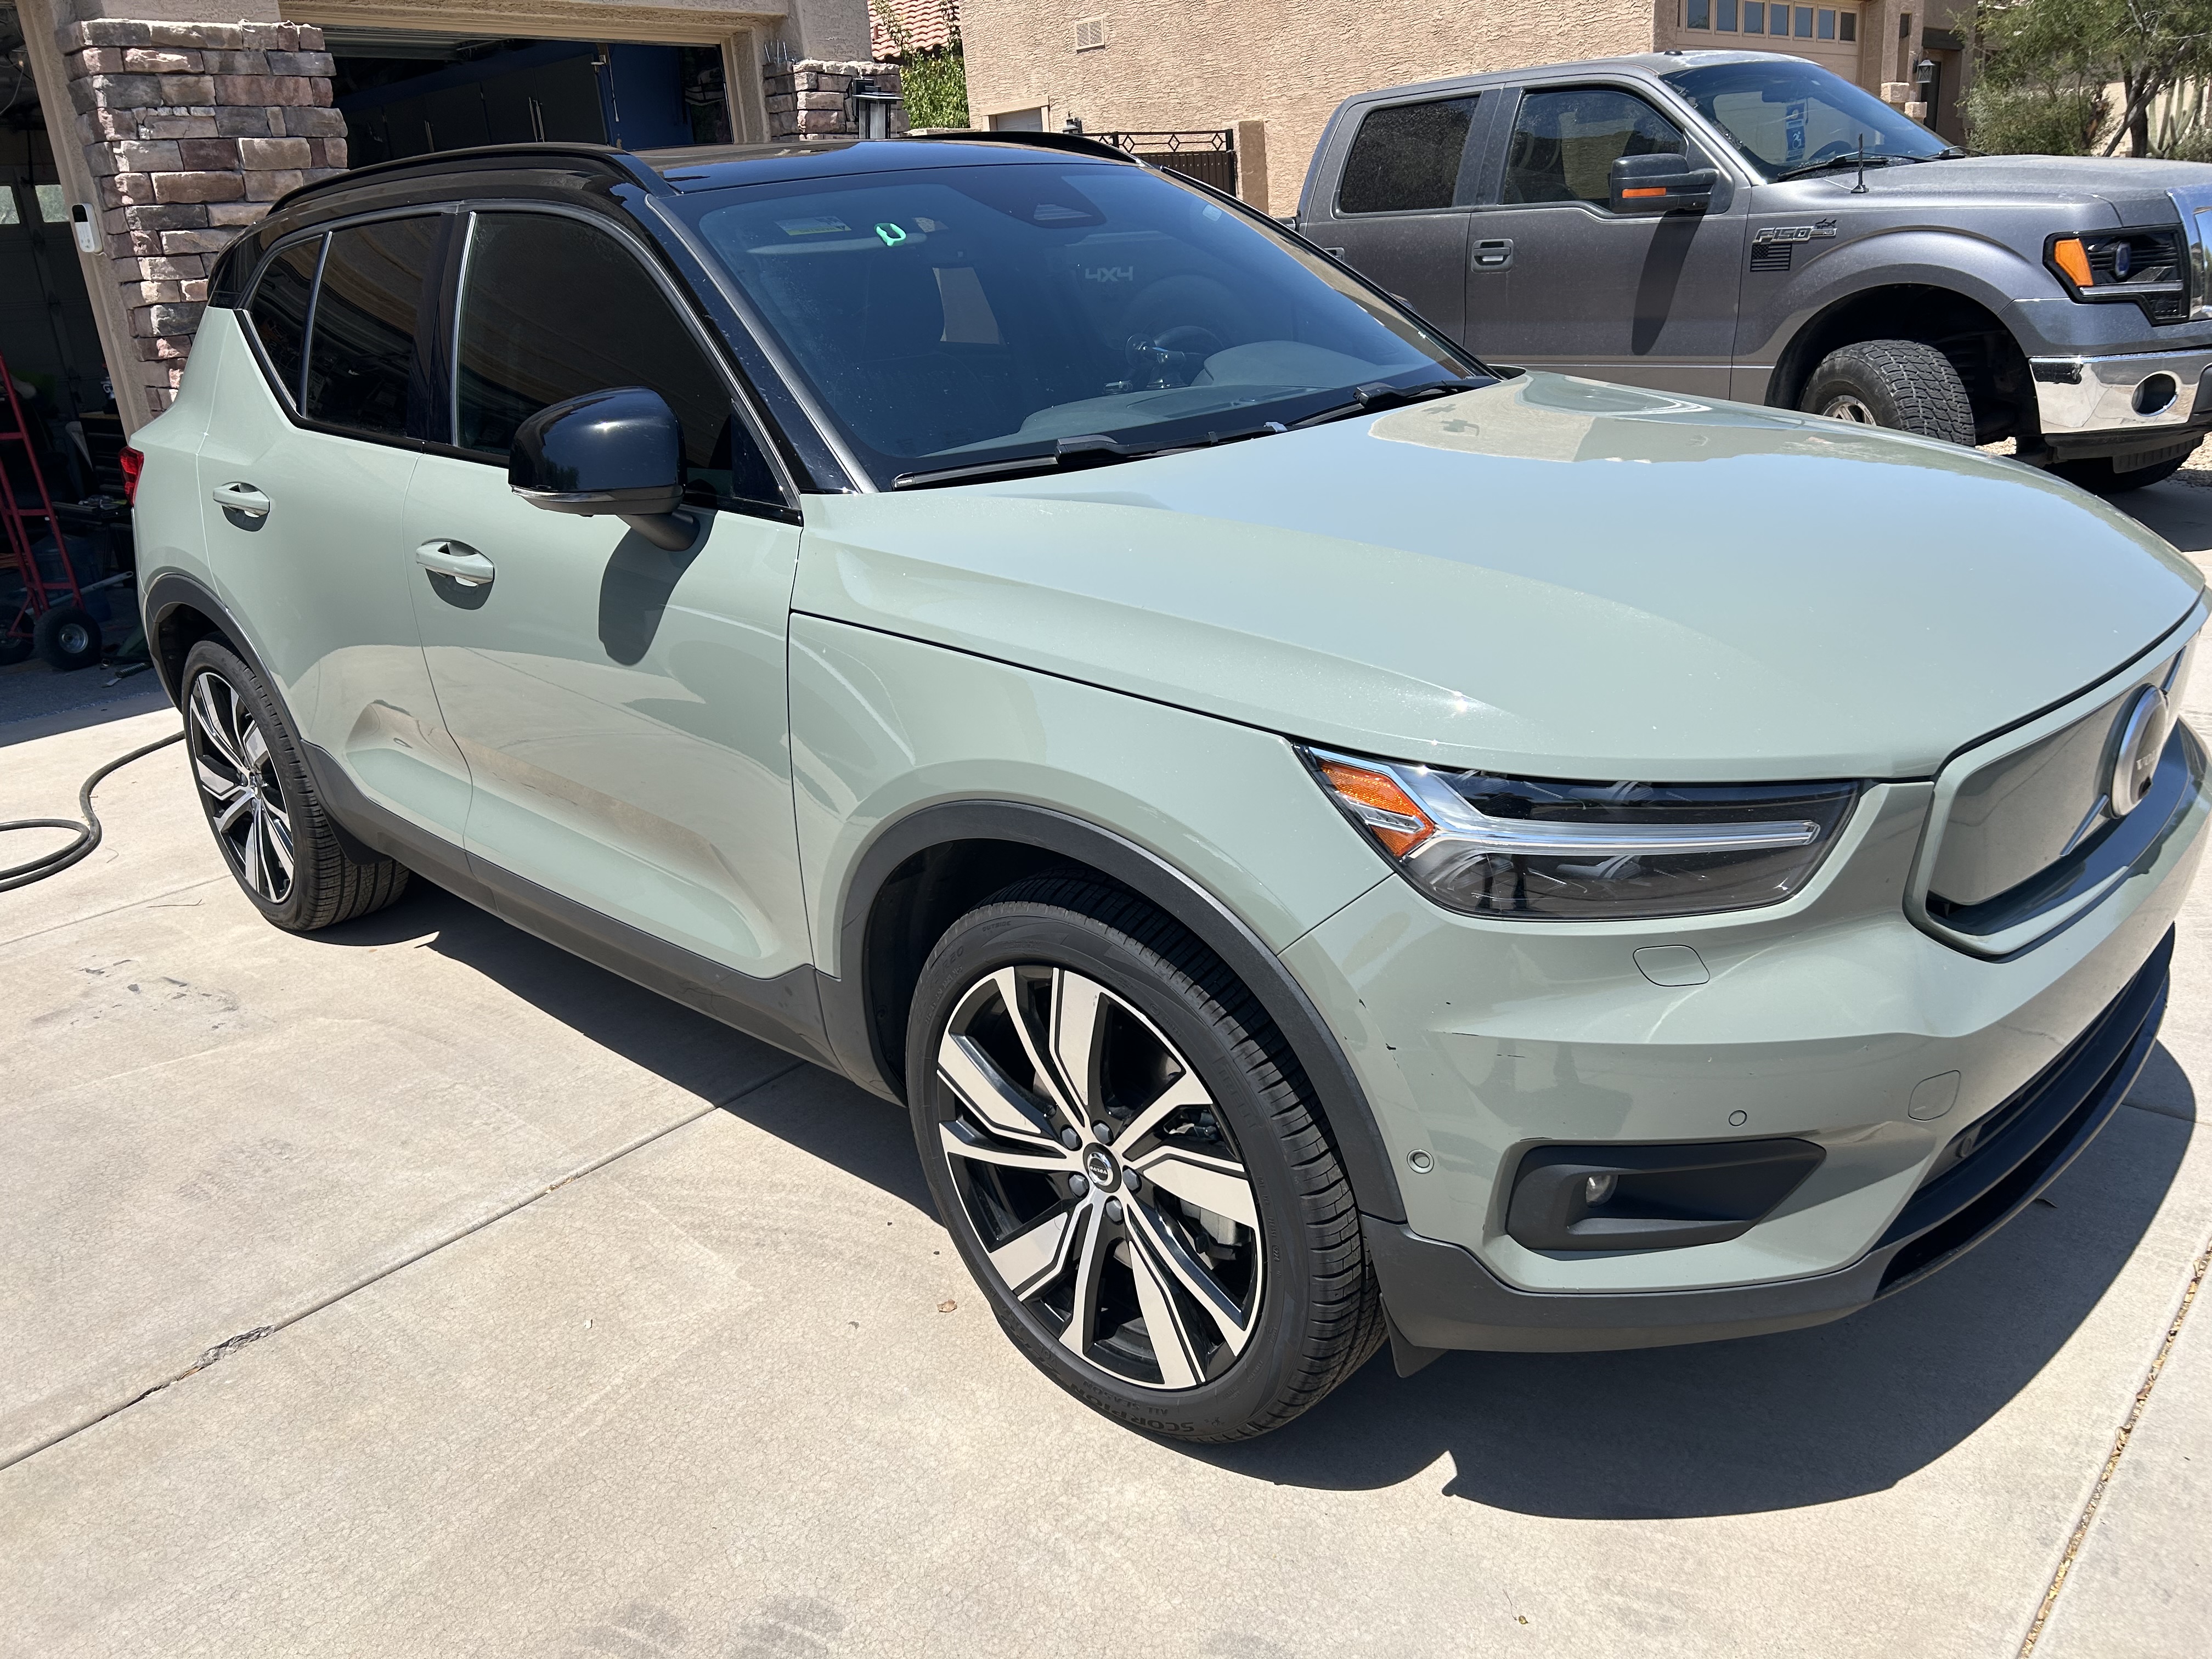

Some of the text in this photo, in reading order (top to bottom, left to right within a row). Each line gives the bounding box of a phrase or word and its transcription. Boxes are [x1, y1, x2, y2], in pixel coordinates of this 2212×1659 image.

[1085, 266, 1133, 282] 4X4
[982, 921, 1011, 932] OUTSIDE
[1071, 1383, 1195, 1432] SCORPION
[1083, 1379, 1168, 1417] ALL SEASON
